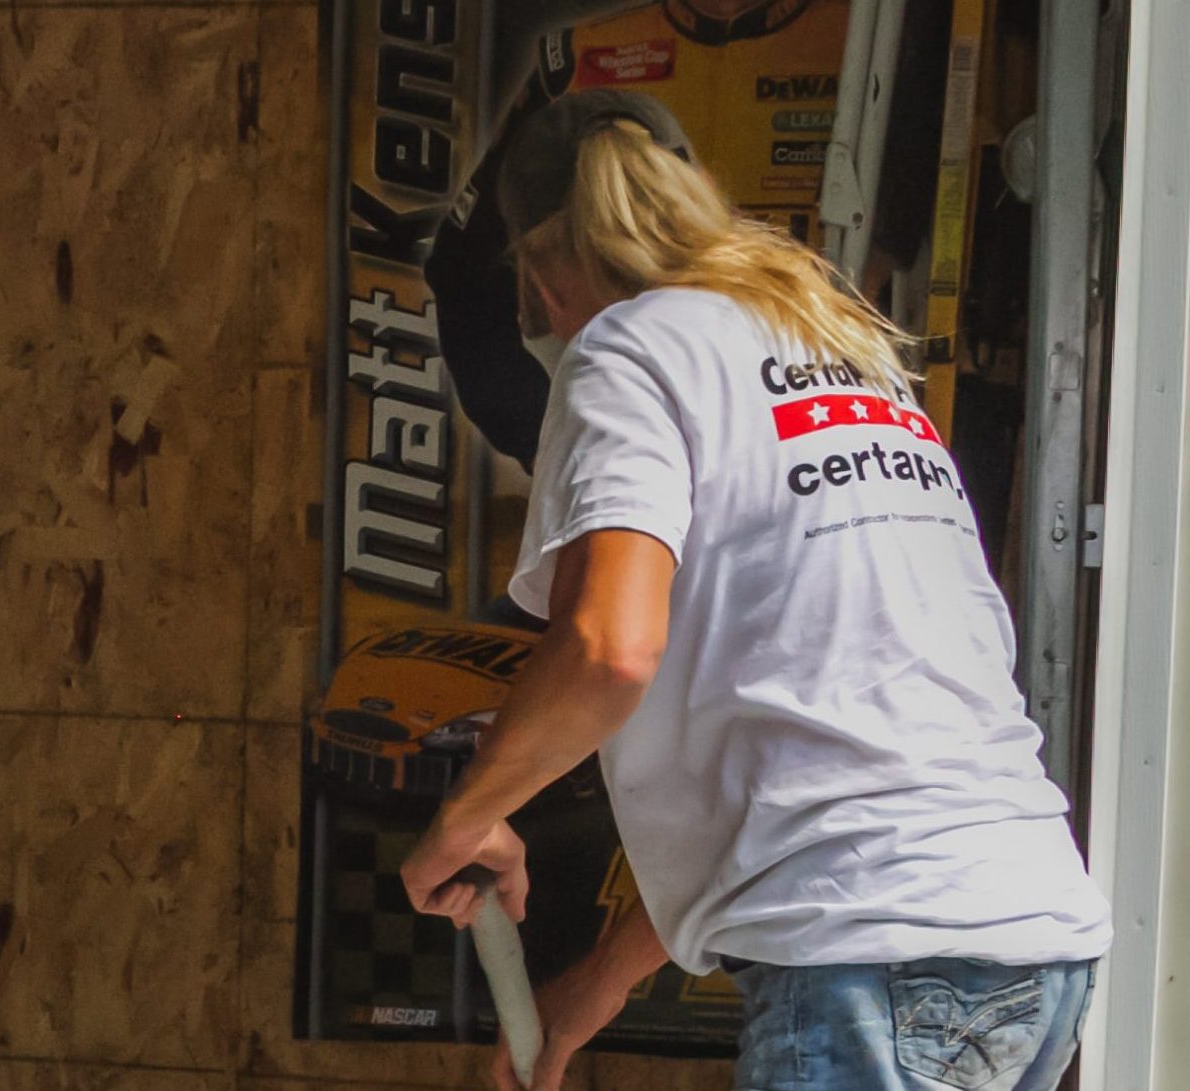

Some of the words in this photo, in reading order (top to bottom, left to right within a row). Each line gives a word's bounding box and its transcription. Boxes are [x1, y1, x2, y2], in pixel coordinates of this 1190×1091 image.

[347, 0, 458, 268] Kens
[341, 289, 450, 599] Matt
[371, 1006, 438, 1028] NASCAR
